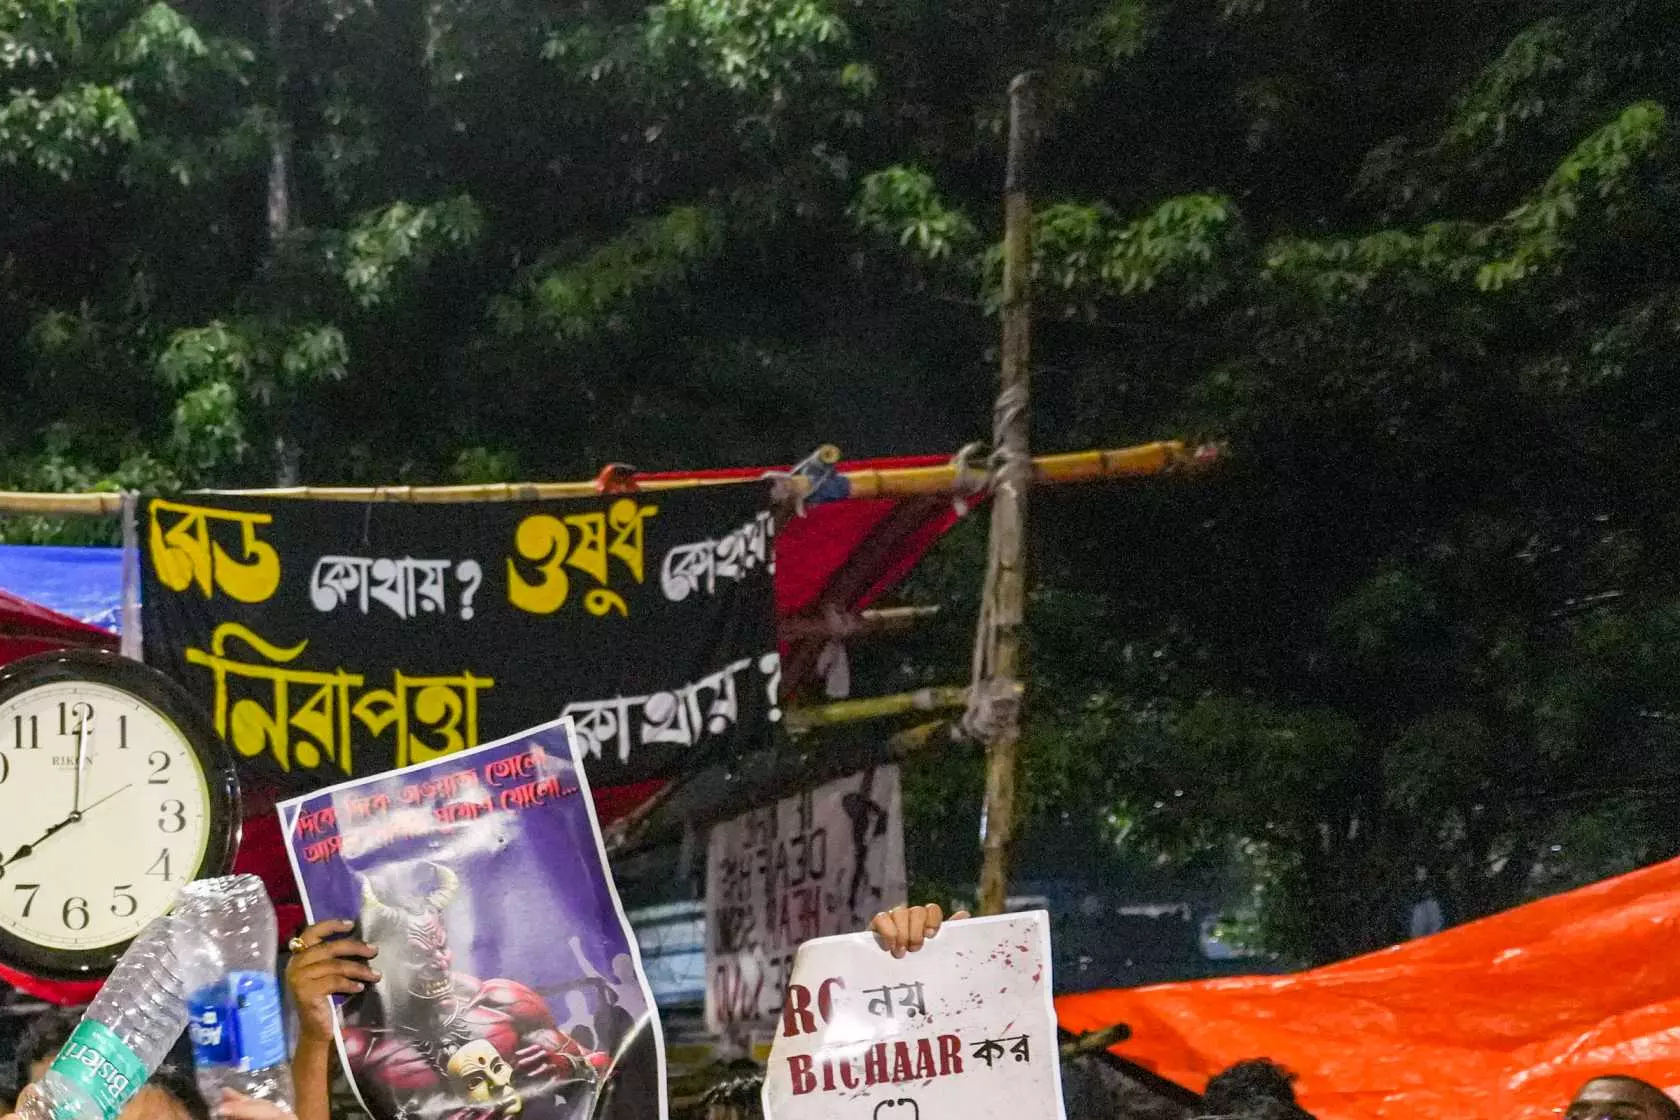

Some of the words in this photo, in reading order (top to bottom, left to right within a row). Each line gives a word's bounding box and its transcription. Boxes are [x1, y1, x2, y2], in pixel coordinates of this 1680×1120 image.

[507, 498, 660, 618] ওষুধ
[186, 621, 494, 774] নিরাপত্তা
[13, 715, 40, 749] 11
[56, 702, 94, 736] 12
[116, 715, 128, 749] 1
[148, 751, 171, 784] 2
[158, 799, 186, 833] 3
[145, 848, 173, 882] 4
[14, 884, 41, 917] 7
[62, 897, 90, 930] 6
[111, 884, 138, 917] 5
[61, 1043, 130, 1099] Bisleri
[786, 1033, 965, 1097] BICHAAR
[969, 1034, 1032, 1068] কর
